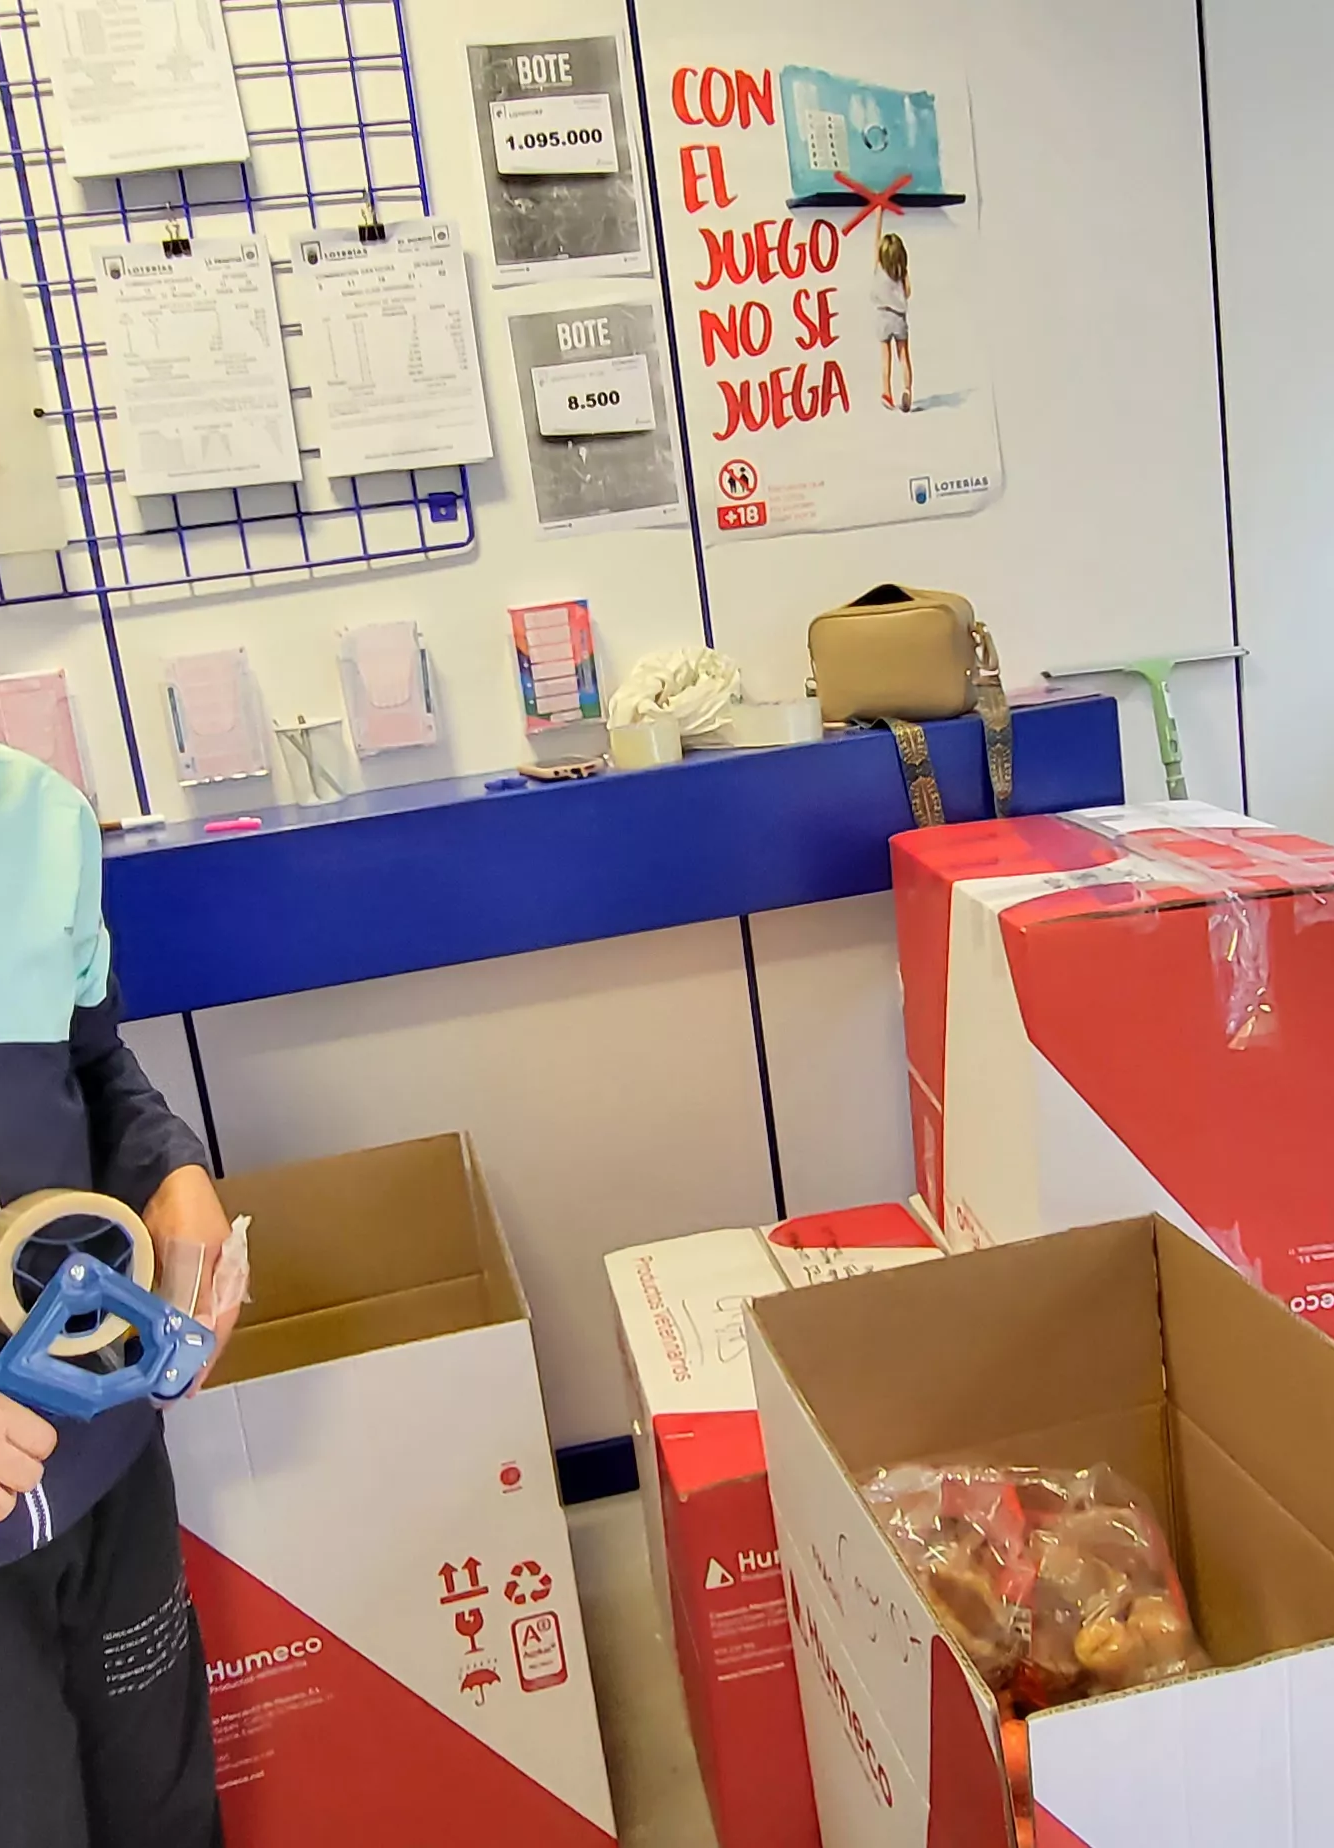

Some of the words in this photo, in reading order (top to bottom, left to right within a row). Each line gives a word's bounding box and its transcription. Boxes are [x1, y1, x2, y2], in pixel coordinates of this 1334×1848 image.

[517, 53, 572, 85] BOTE
[672, 67, 775, 129] CON
[506, 128, 603, 151] 1.095.000
[680, 145, 739, 213] EL
[694, 218, 839, 290] JUEGO
[557, 318, 611, 351] BOTE
[699, 301, 772, 367] NO
[793, 287, 840, 350] SE
[567, 390, 621, 410] 8.500
[712, 360, 850, 441] JUEGA
[934, 476, 989, 492] LOTERÍAS
[724, 505, 760, 525] +18
[206, 1636, 323, 1684] Humeco
[805, 1603, 893, 1809] Humeco
